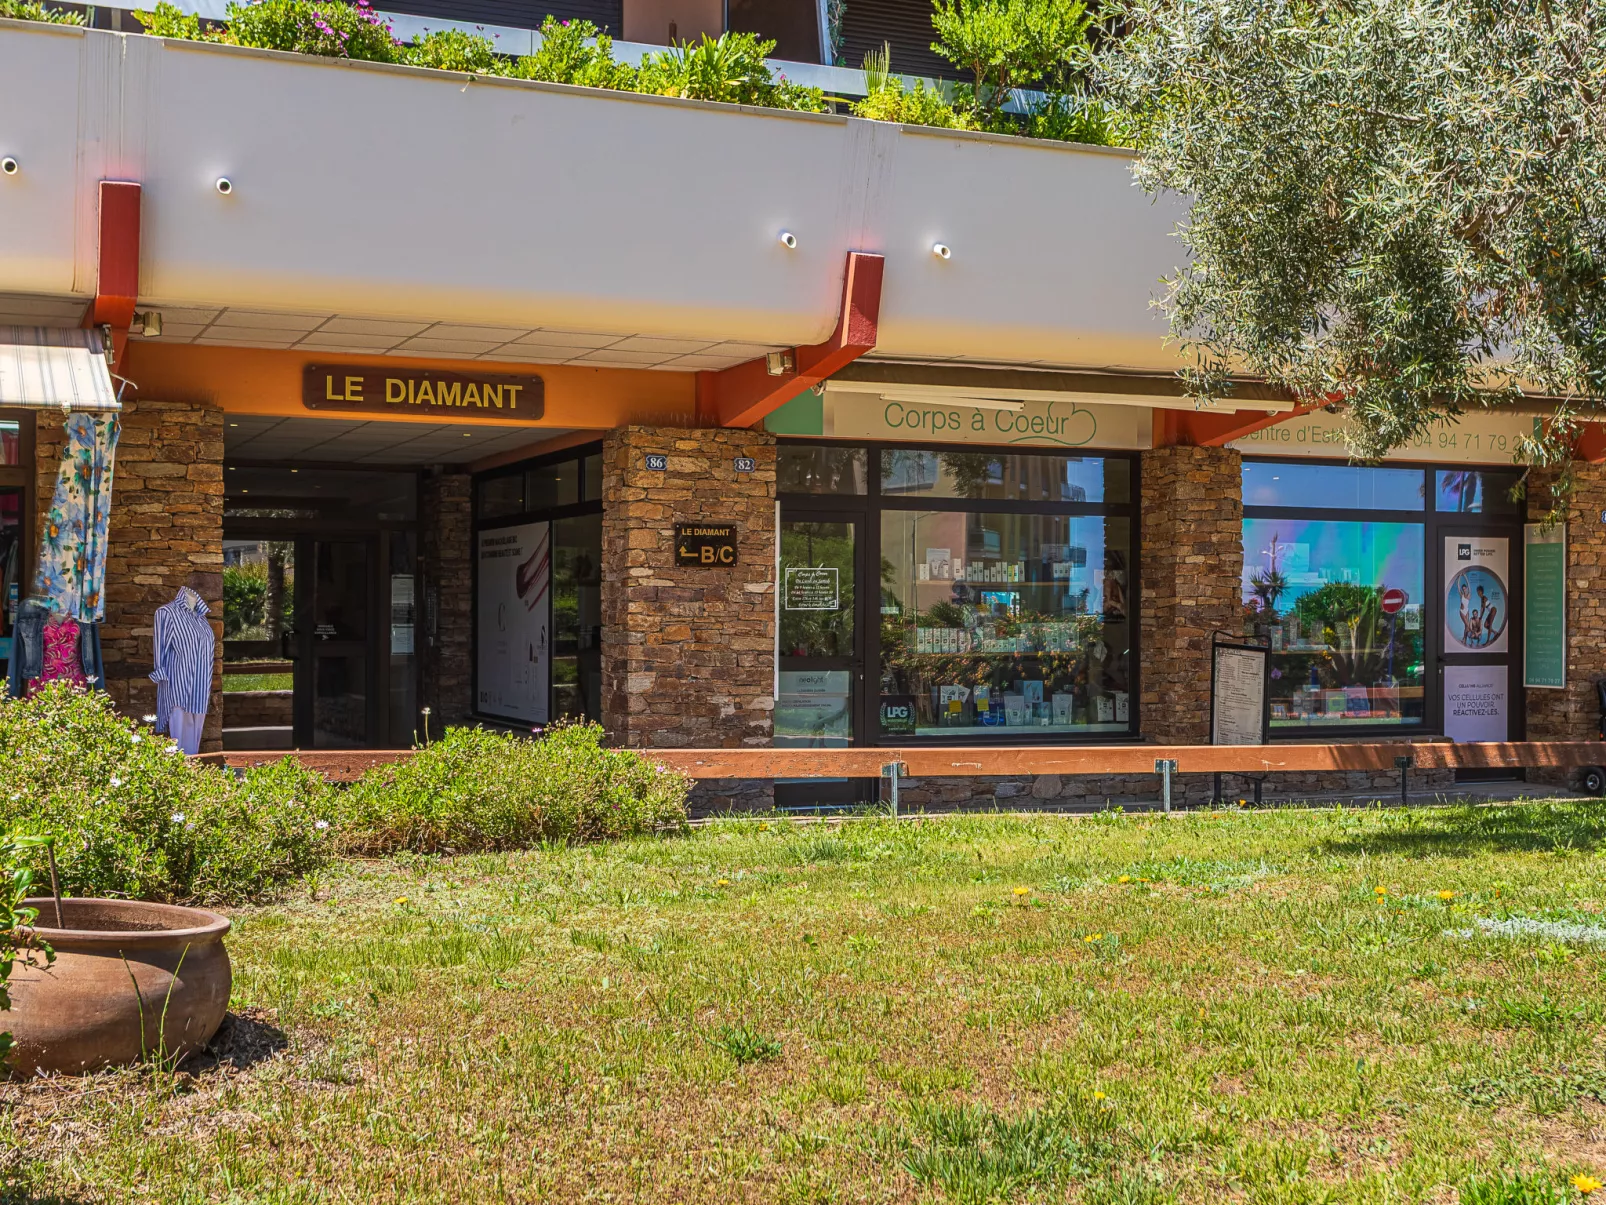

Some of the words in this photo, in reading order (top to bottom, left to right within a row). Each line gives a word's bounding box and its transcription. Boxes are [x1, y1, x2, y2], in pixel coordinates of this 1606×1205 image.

[326, 375, 364, 402] LE
[385, 378, 523, 409] DIAMANT
[884, 402, 961, 435] Corps
[970, 407, 986, 431] à
[994, 409, 1069, 435] Coeur
[1239, 425, 1291, 442] entre
[1413, 433, 1433, 447] 04
[1438, 432, 1457, 449] 94
[1464, 433, 1480, 450] 71
[1488, 434, 1507, 451] 79
[650, 457, 663, 469] 86
[738, 459, 751, 470] 82
[681, 528, 692, 536] LE
[693, 528, 730, 536] DIAMANT
[701, 545, 734, 564] B/C
[1459, 548, 1471, 556] LPG
[1448, 693, 1461, 701] VOS
[1461, 693, 1491, 701] CELLULES
[1491, 693, 1505, 701] ONT
[1456, 701, 1467, 709] UN
[887, 706, 908, 718] LPG
